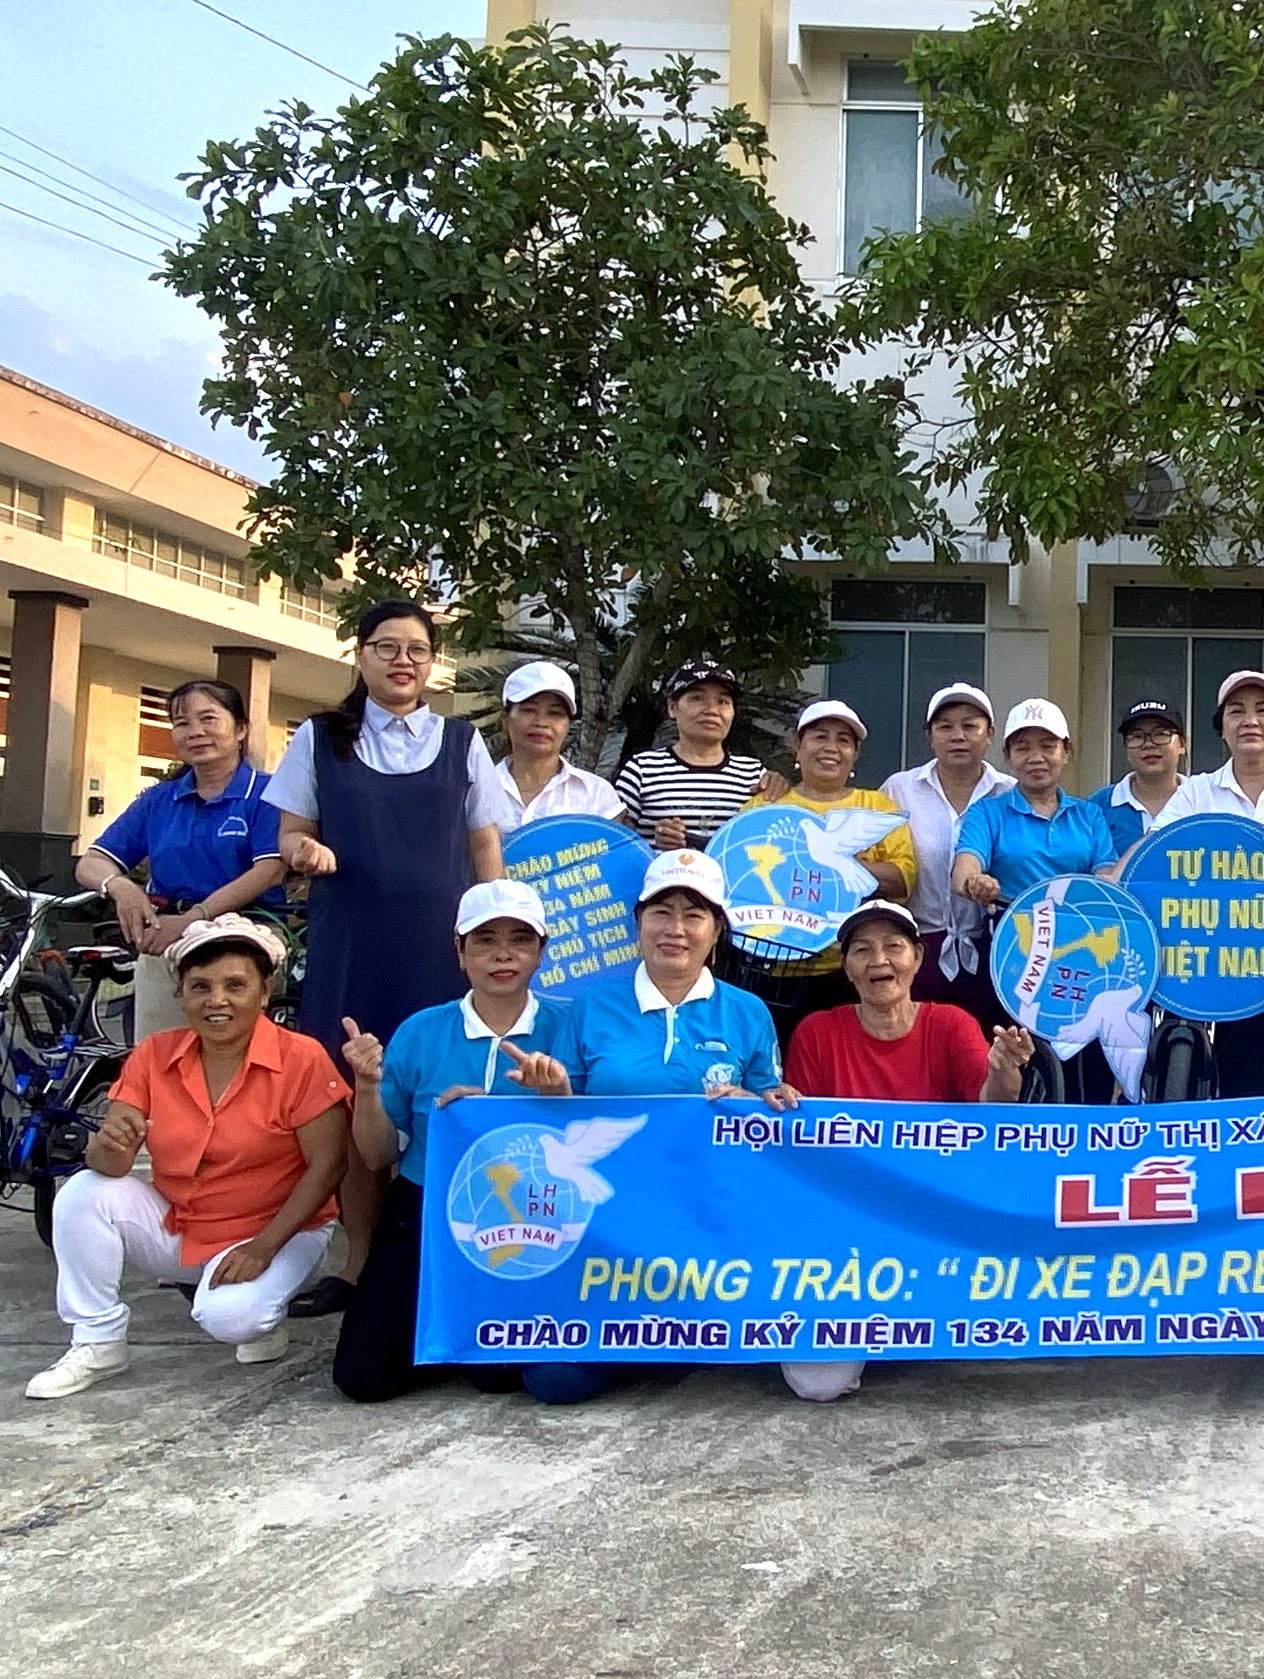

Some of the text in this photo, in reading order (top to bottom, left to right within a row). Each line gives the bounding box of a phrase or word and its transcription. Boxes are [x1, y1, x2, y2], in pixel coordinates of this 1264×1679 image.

[782, 908, 820, 930] NAM
[1161, 896, 1220, 935] PHỤ
[712, 1112, 784, 1152] HỘI
[793, 1111, 882, 1148] LIÊN
[893, 1119, 987, 1156] HIỆP
[994, 1123, 1078, 1157] PHỤ
[1088, 1119, 1147, 1151] NỮ
[1157, 1119, 1221, 1152] THỊ
[1054, 1154, 1199, 1229] LỄ
[479, 1226, 558, 1248] VIET NAM
[577, 1255, 751, 1303] PHONG
[769, 1246, 920, 1302] TRÀO:
[1026, 1254, 1097, 1301] XE
[1106, 1249, 1208, 1308] ĐẠP
[475, 1313, 589, 1350] CHÀO
[600, 1312, 730, 1350] MỪNG
[739, 1310, 809, 1348] KỶ
[813, 1314, 934, 1354] NIỆM
[946, 1317, 1028, 1347] 134
[1040, 1309, 1146, 1347] NĂM
